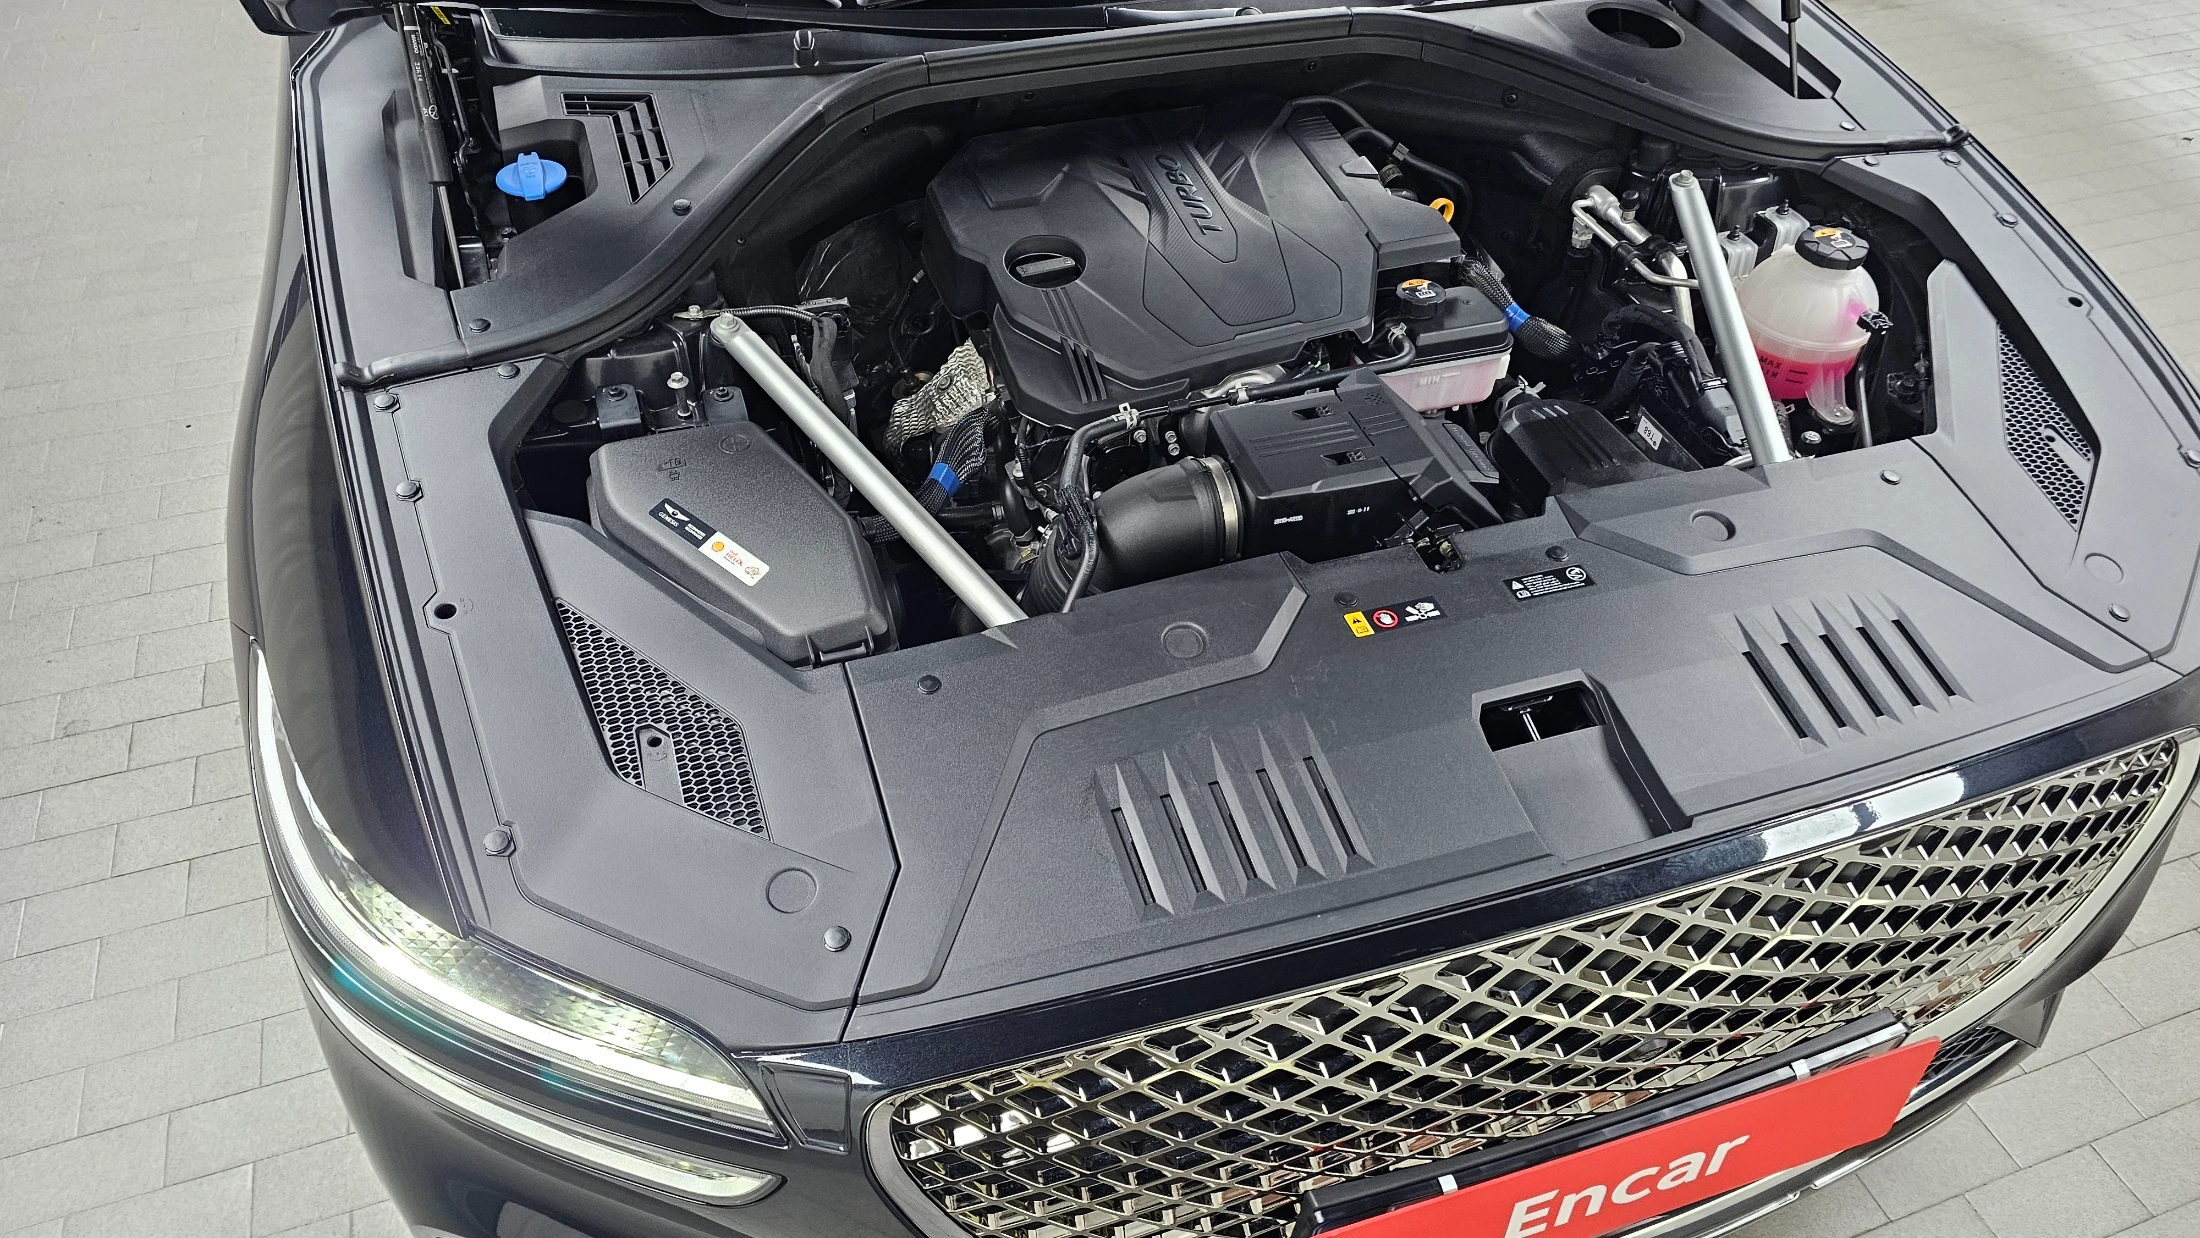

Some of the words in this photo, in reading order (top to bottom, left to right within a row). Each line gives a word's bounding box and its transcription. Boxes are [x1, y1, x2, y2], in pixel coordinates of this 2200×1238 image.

[411, 34, 419, 54] MANDO
[1155, 153, 1223, 236] TURBO
[1759, 355, 1783, 370] MAX
[1418, 374, 1441, 387] MIN
[1762, 367, 1779, 378] IN
[658, 511, 680, 527] GENESIS
[1504, 1134, 1751, 1238] Encar
